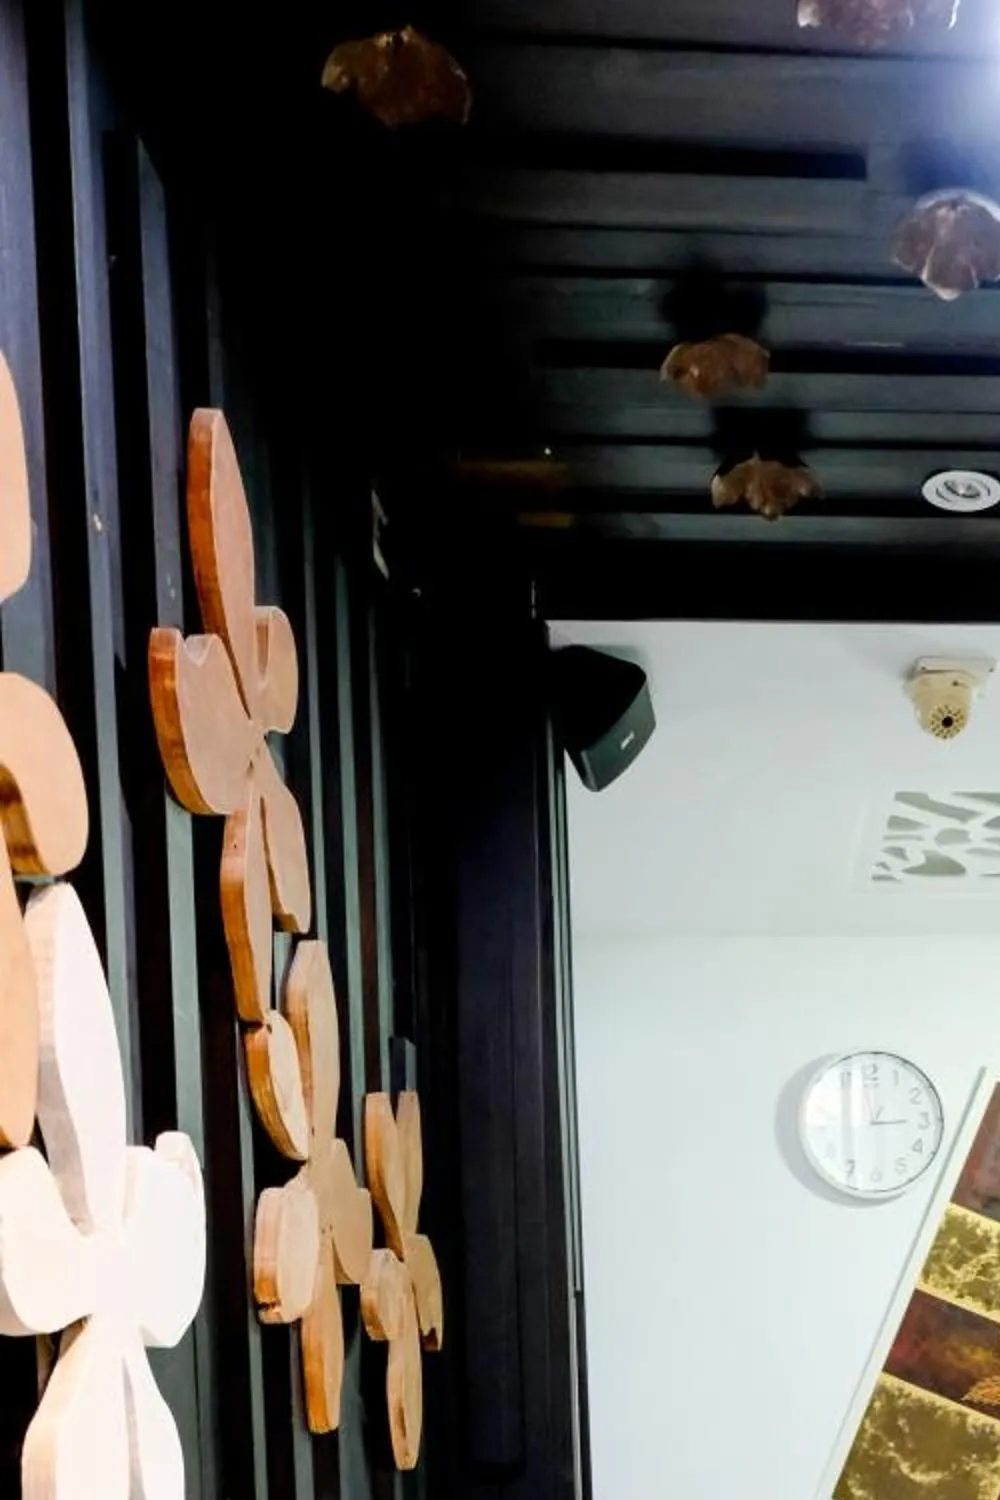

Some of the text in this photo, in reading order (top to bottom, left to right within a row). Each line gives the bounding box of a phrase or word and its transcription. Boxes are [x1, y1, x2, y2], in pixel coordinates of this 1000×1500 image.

[908, 1086, 923, 1106] 2
[917, 1111, 930, 1131] 3
[911, 1137, 924, 1155] 4
